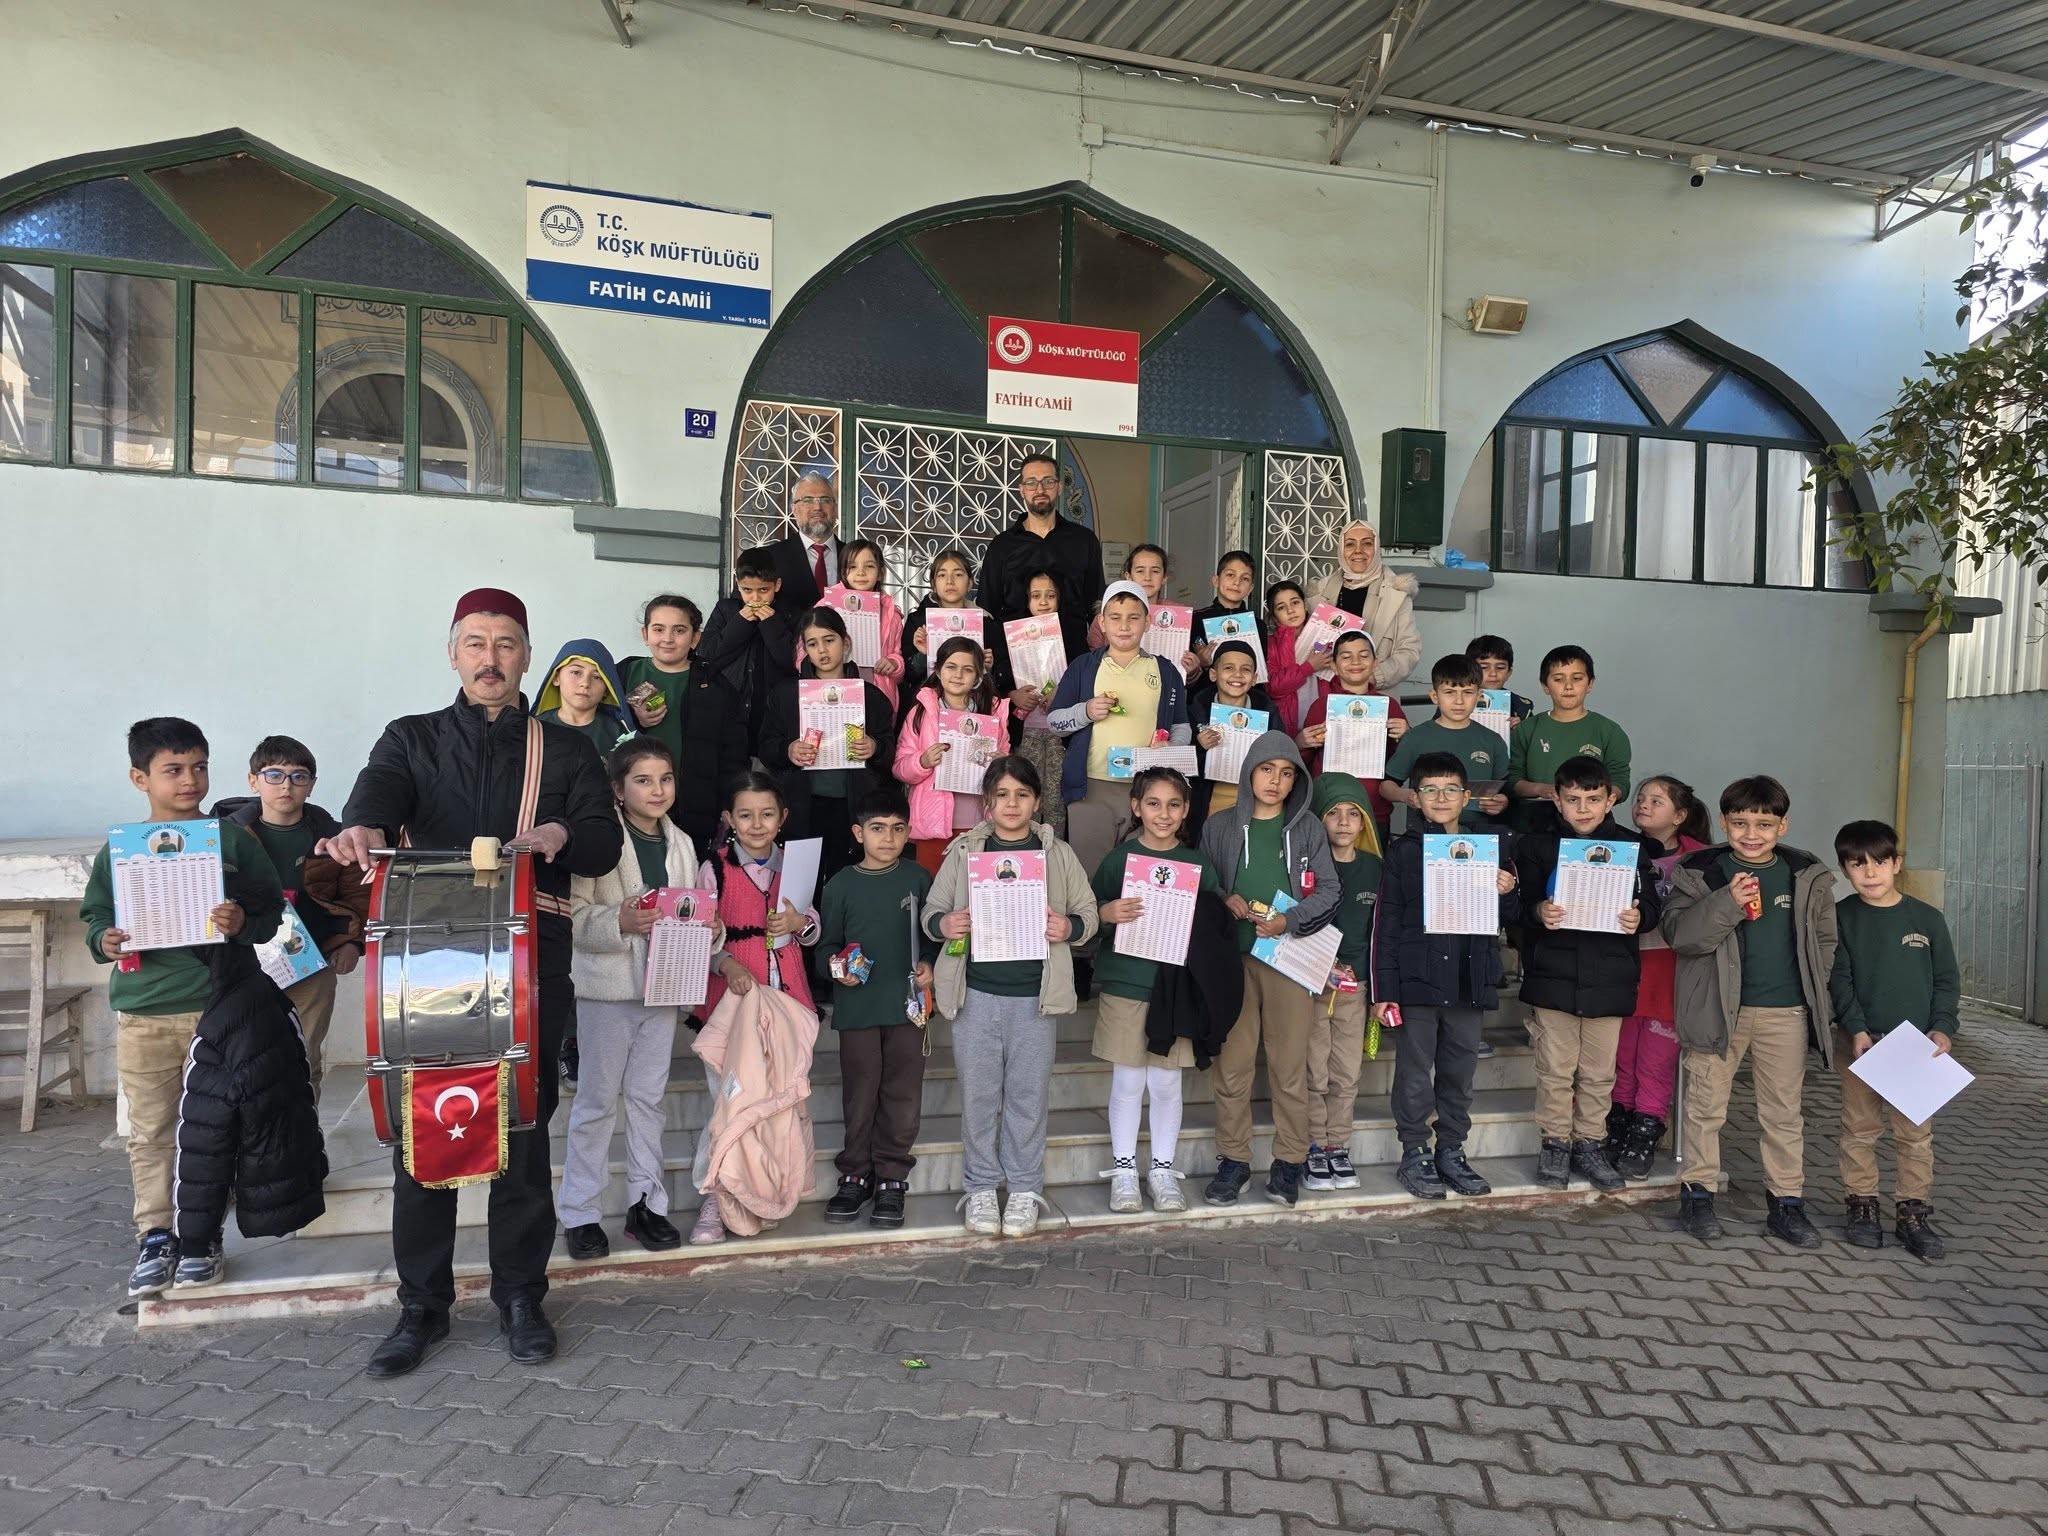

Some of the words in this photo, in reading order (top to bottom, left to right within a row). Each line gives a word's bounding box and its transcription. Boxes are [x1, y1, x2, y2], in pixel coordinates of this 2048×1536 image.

[597, 213, 628, 231] T.C.
[597, 234, 645, 258] KÖŞK
[650, 242, 759, 271] MÜFTÜLÜĞÜ
[589, 280, 646, 302] FATİH
[652, 289, 711, 310] CAMİİ
[748, 317, 767, 326] 1994
[1038, 343, 1065, 356] KÖŞK
[1066, 346, 1127, 362] MÜFTÜLÜĞÜ
[995, 392, 1033, 407] FATİH
[1035, 396, 1072, 411] CAMİİ
[692, 413, 709, 427] 20
[1118, 424, 1134, 433] 1994
